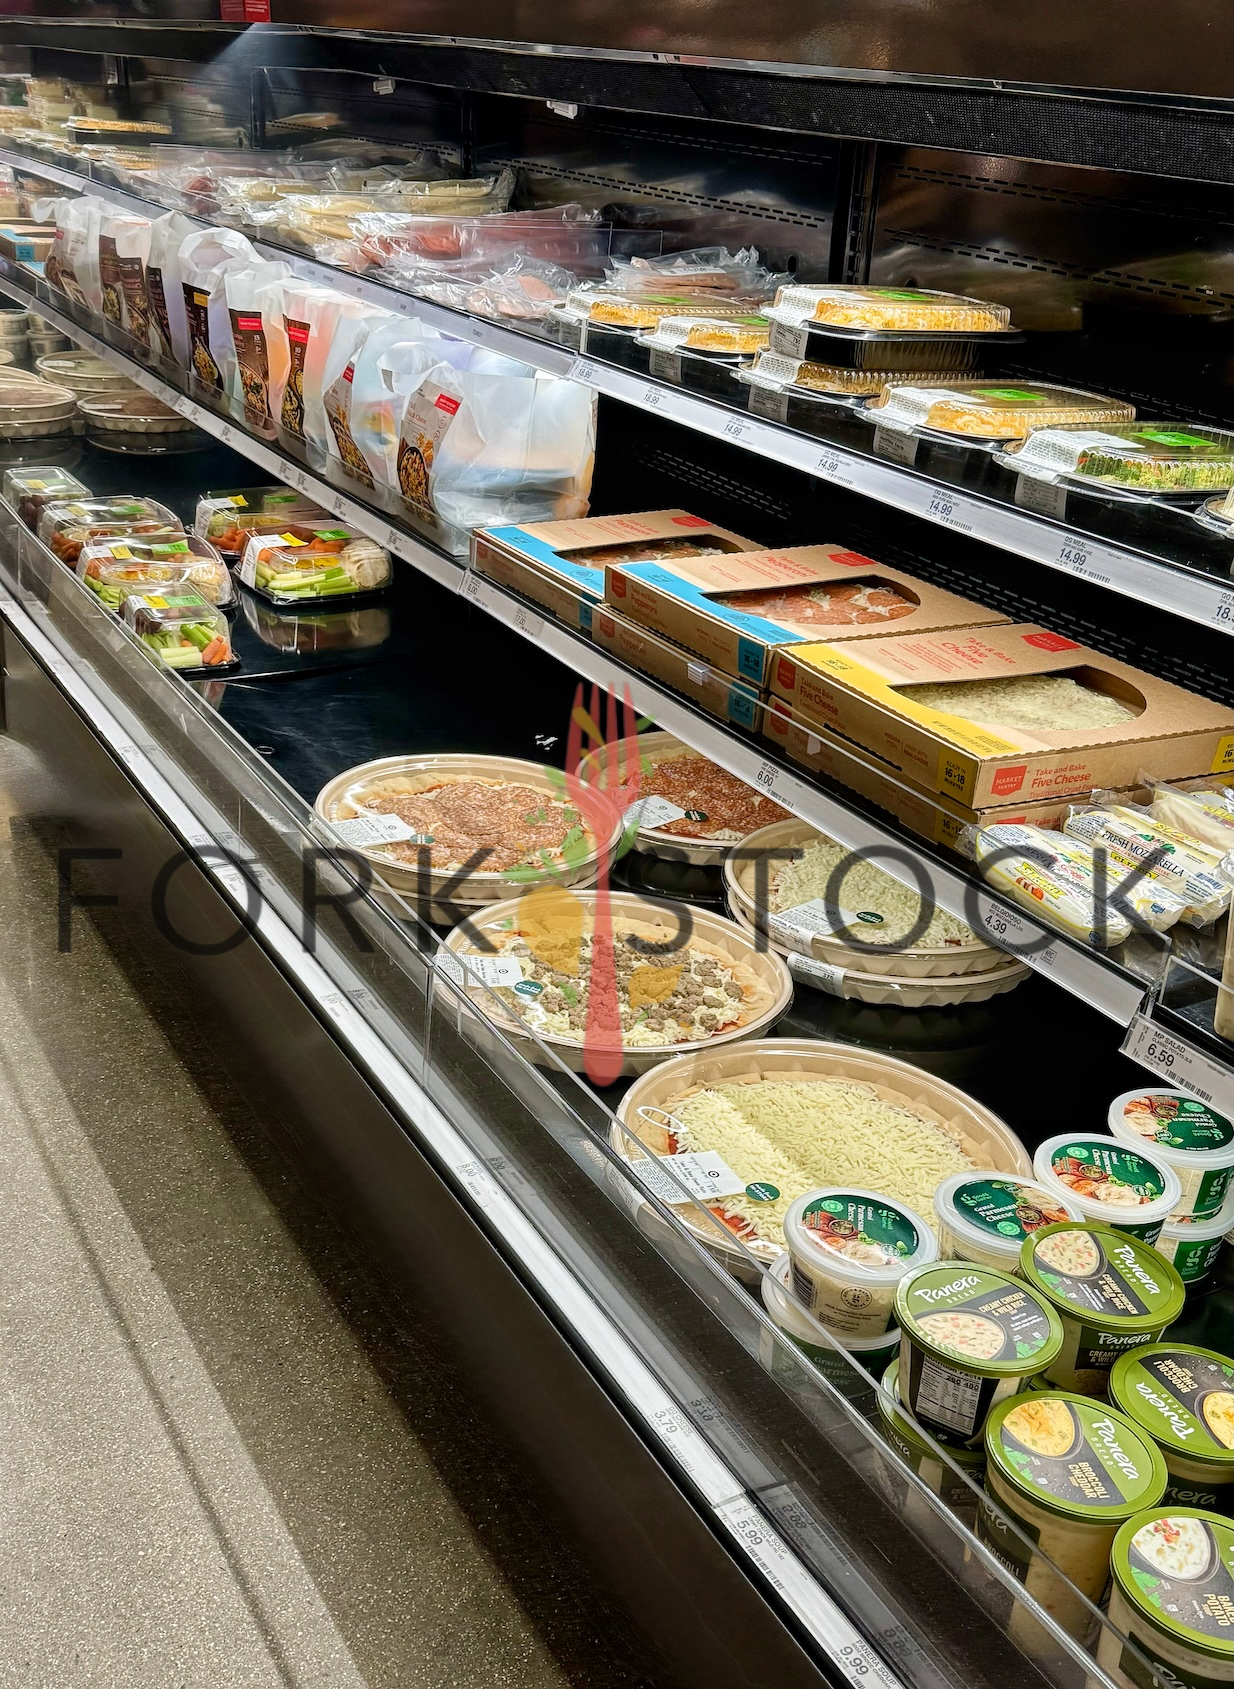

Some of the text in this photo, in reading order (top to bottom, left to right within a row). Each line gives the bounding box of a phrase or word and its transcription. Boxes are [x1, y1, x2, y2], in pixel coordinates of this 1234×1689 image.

[724, 423, 743, 436] 14.99
[818, 458, 838, 472] 14.99
[930, 500, 953, 516] 14.99
[1072, 539, 1087, 549] MEAL
[1060, 548, 1086, 565] 14.99
[942, 642, 983, 665] Cheese
[965, 645, 989, 659] Five
[800, 685, 839, 716] Five Cheese
[757, 770, 774, 787] 6.00
[995, 775, 1022, 786] MARKET
[1031, 772, 1092, 789] Five Cheese
[1035, 763, 1086, 777] Take and Bake
[997, 782, 1017, 790] PANTRY
[1029, 788, 1063, 799] Traditional
[1064, 785, 1081, 795] Crust
[1035, 817, 1060, 827] Take an
[1102, 830, 1129, 849] FRESH
[1129, 840, 1185, 877] MOZZARELLA
[985, 915, 1007, 934] 4.39
[991, 903, 1022, 925] BELGIOIOSO
[1044, 949, 1055, 959] WIC
[1151, 1037, 1169, 1050] CLASSIC
[1168, 1046, 1185, 1060] POTATO
[1153, 1031, 1186, 1054] MP SALAD
[1147, 1043, 1175, 1067] 6.59
[974, 1203, 995, 1213] Grated
[979, 1204, 1019, 1217] Parmesan
[985, 1211, 1015, 1223] Cheese
[1114, 1244, 1161, 1295] Panera
[1114, 1259, 1137, 1284] BREAD
[914, 1275, 982, 1303] Panera
[948, 1288, 976, 1304] BREAD
[1102, 1274, 1139, 1315] CREAMY CHICKEN
[1102, 1285, 1117, 1301] WILD
[1112, 1295, 1127, 1310] RICE
[978, 1291, 1026, 1313] CREAMY CHICKEN
[998, 1304, 1014, 1315] WILD
[1012, 1300, 1027, 1310] RICE
[1098, 1332, 1151, 1345] Panera
[814, 1356, 845, 1367] Grated
[1089, 1350, 1119, 1358] CREAMY
[1153, 1361, 1192, 1394] BROCCOLI
[1163, 1359, 1199, 1390] CHEDDAR
[1136, 1381, 1195, 1440] Panera
[1158, 1391, 1190, 1419] BREAD
[655, 1410, 678, 1433] 3.79
[676, 1414, 695, 1436] CHEESE
[1090, 1437, 1115, 1469] BREAD
[1092, 1418, 1139, 1480] Panera
[1067, 1464, 1096, 1499] CHEDDAR
[1077, 1461, 1110, 1499] BROCCOLI
[1167, 1486, 1217, 1505] nera
[737, 1520, 763, 1546] 5.99
[752, 1514, 788, 1555] PANERA SOUP
[1203, 1593, 1231, 1627] POTATO
[840, 1646, 869, 1676] 9.99
[851, 1643, 862, 1656] 32OZ
[860, 1653, 875, 1669] BROCC
[855, 1640, 897, 1686] PANERA SOUP
